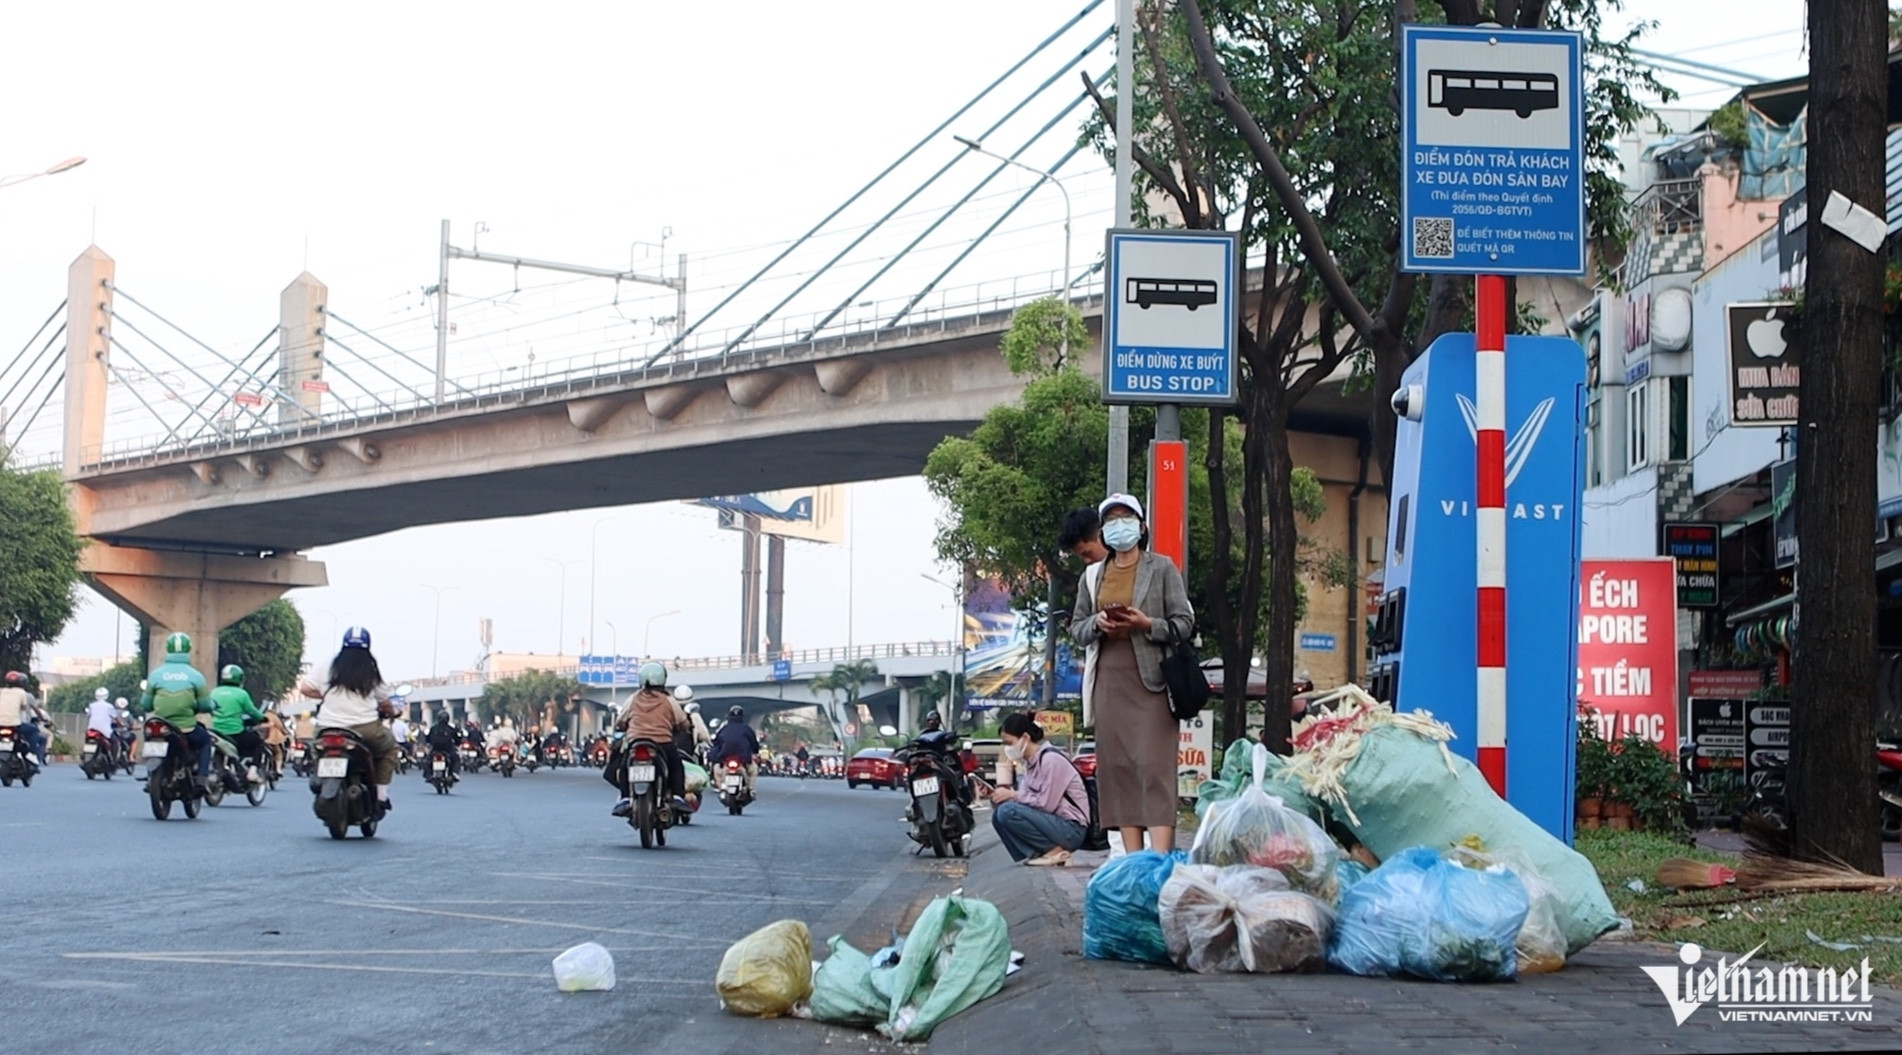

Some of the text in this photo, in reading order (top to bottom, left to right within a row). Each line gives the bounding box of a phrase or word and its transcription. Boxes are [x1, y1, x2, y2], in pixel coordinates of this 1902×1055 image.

[1414, 148, 1570, 169] ĐIỂM ĐÓN TRẢ KHÁCH
[1416, 170, 1568, 188] XE ĐƯA ĐÓN SÂN BAY
[1452, 190, 1476, 201] điểm
[1478, 192, 1499, 202] theo
[1502, 191, 1530, 204] Quyết
[1532, 193, 1553, 206] định
[1473, 226, 1492, 239] BIẾT
[1496, 228, 1521, 240] THÊM
[1524, 228, 1556, 240] THÔNG
[1558, 231, 1574, 240] TIN
[1457, 242, 1482, 253] QUÉT
[1501, 244, 1514, 253] QR
[1117, 349, 1224, 370] ĐIỂM DỪNG XE BUÝT
[1127, 375, 1214, 391] BUS STOP
[1738, 362, 1800, 388] MUA BÁN
[1737, 392, 1765, 420] SỬA
[1441, 500, 1564, 520] VIAST
[1590, 570, 1638, 608] ẾCH
